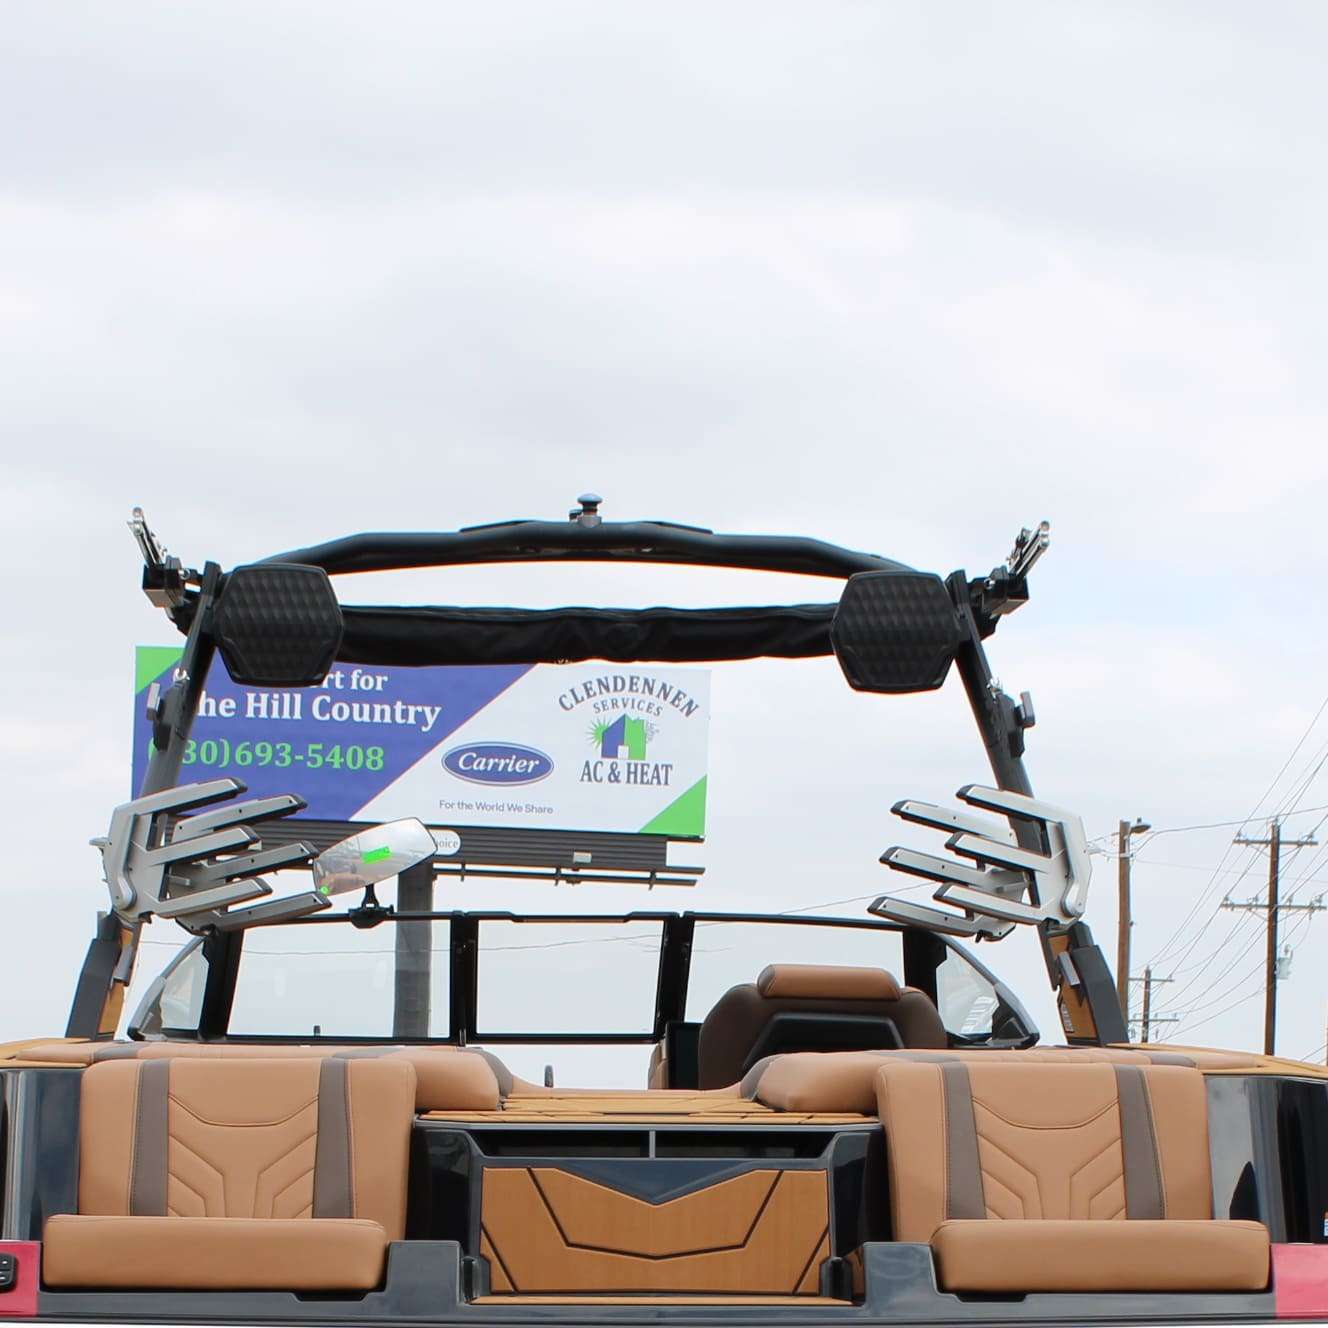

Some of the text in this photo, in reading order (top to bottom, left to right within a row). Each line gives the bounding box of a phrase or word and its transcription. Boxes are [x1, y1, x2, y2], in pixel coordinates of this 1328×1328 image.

[351, 668, 388, 691] for
[558, 675, 699, 718] CLENDENNEN
[593, 697, 663, 718] SERVICES
[197, 690, 442, 732] he Hill Country
[148, 737, 385, 771] (30)693-5408
[458, 752, 540, 773] Carrier
[580, 759, 673, 786] AC & HEAT
[439, 800, 554, 814] For the World We Share
